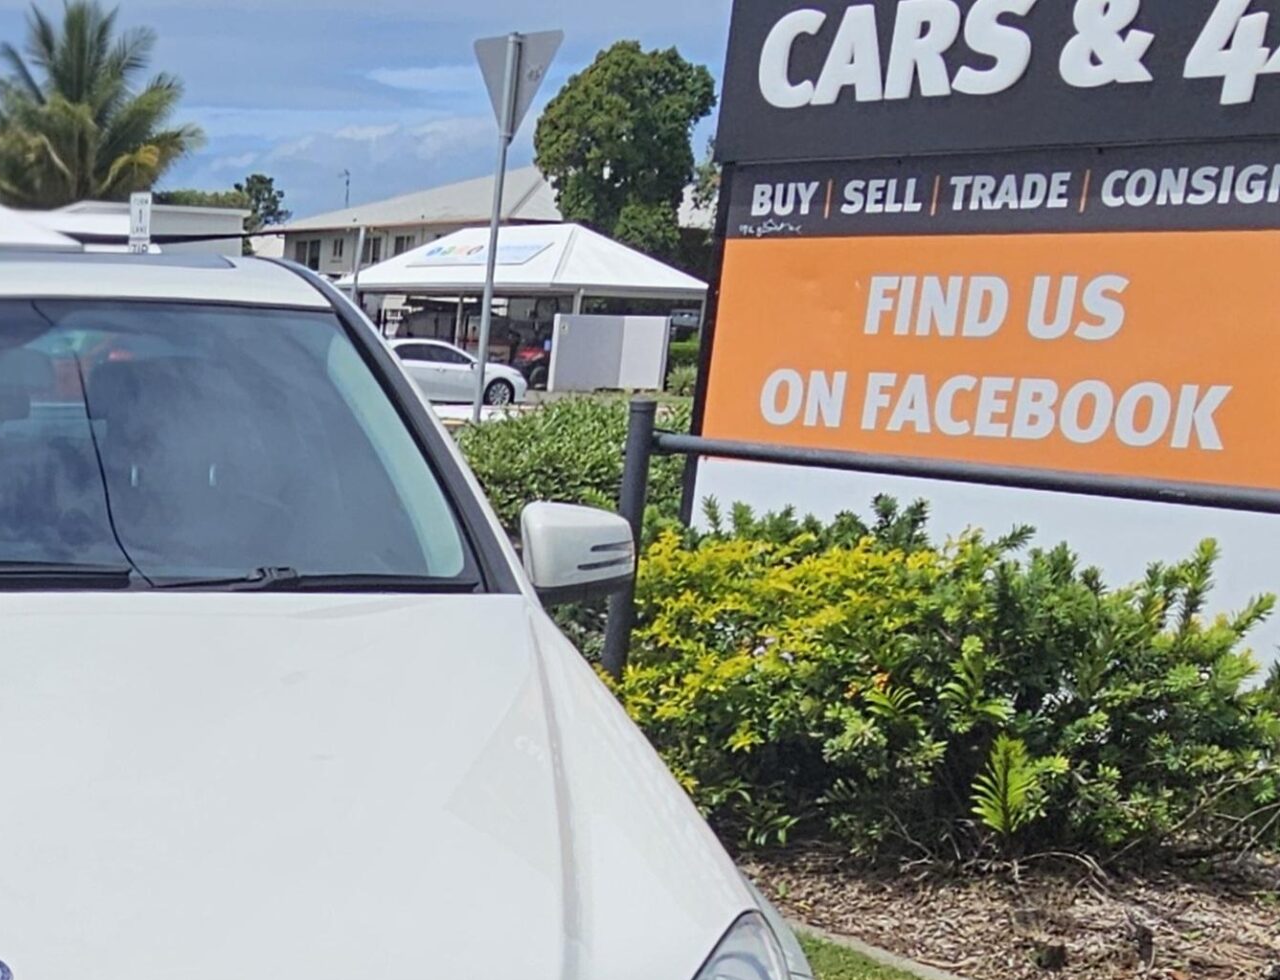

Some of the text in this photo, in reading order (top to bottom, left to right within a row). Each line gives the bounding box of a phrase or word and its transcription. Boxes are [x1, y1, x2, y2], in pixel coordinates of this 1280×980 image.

[758, 0, 1280, 108] CARS & 4
[750, 181, 819, 216] BUY
[839, 177, 923, 214] SELL
[949, 171, 1072, 211] TRADE
[863, 273, 1130, 341] FIND US
[759, 368, 1231, 451] ON FACEBOOK
